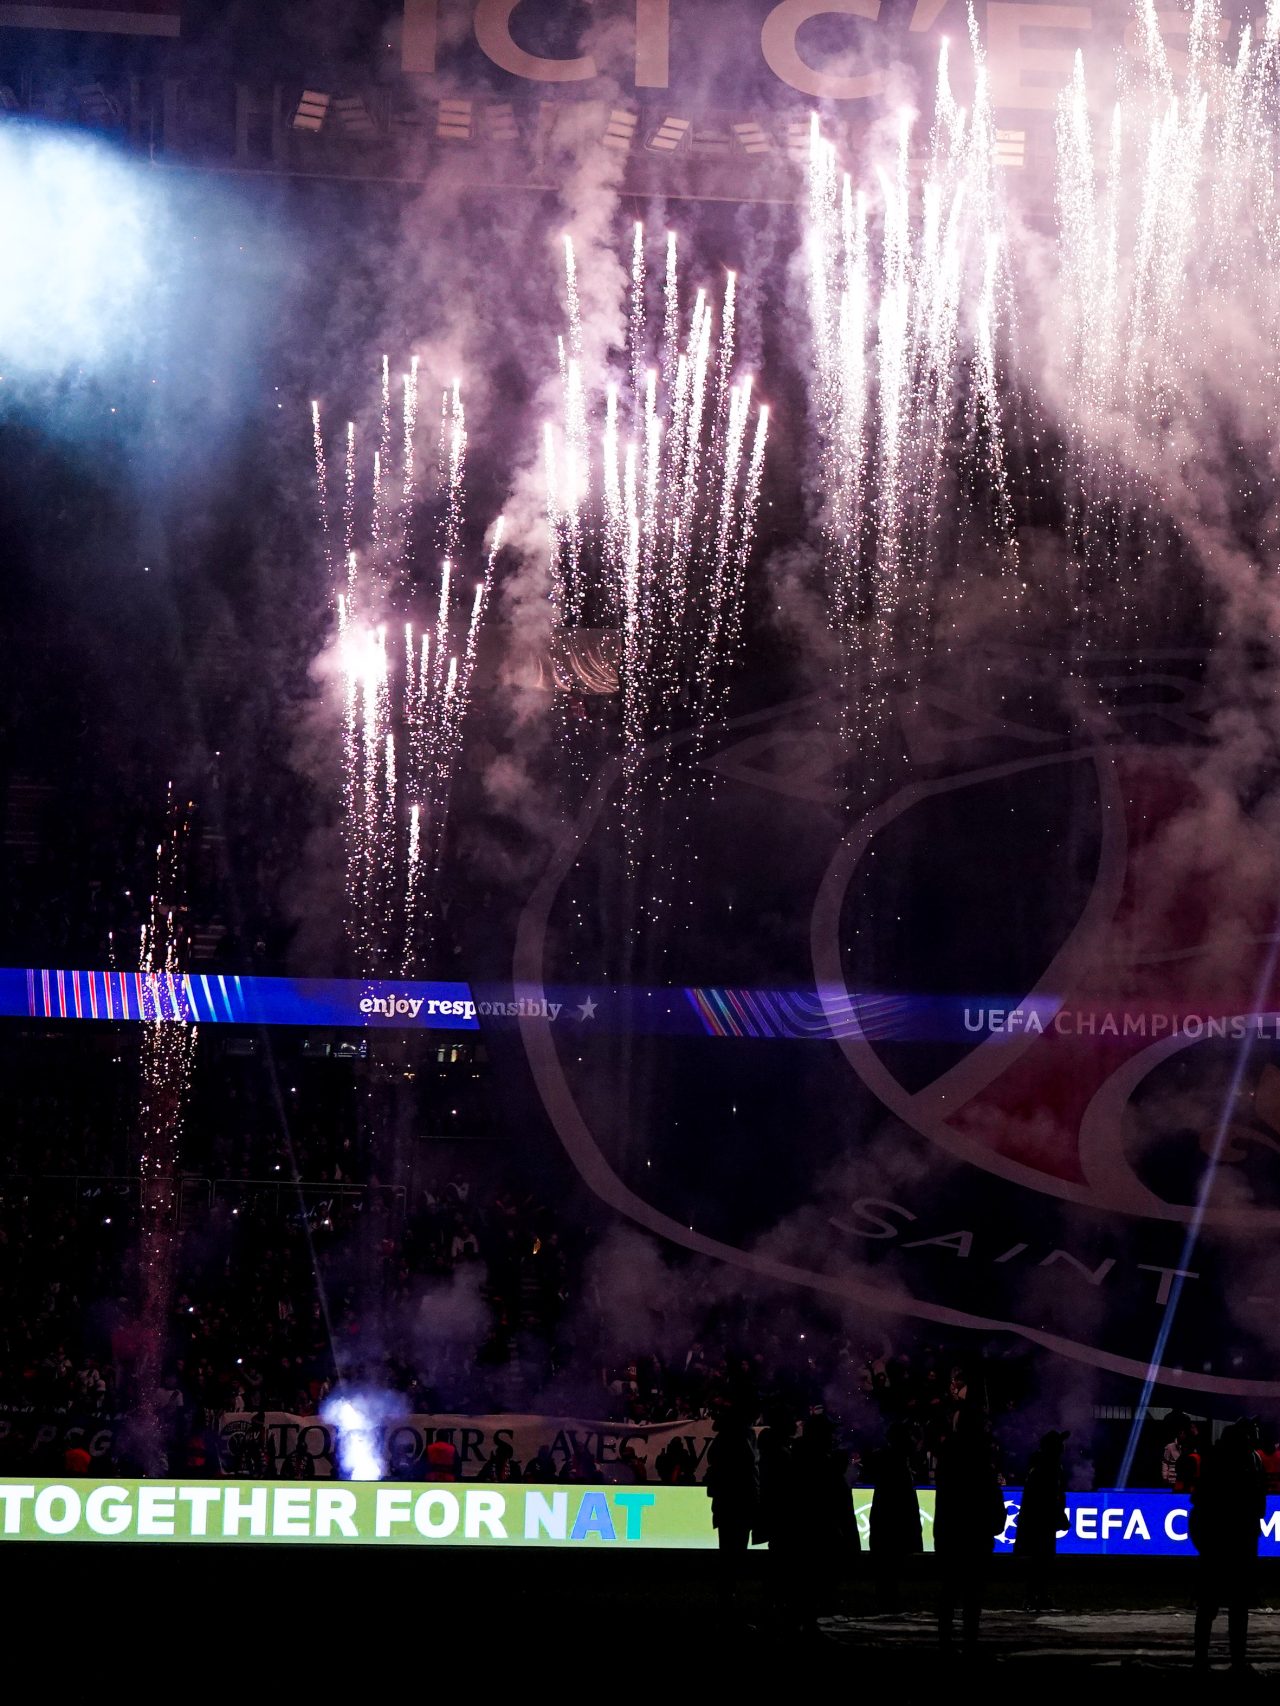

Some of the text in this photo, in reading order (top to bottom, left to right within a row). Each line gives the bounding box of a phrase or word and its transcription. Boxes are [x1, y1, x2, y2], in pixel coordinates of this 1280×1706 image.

[359, 994, 562, 1021] enjoy responsibly
[964, 1008, 1044, 1034] UEFA
[1054, 1010, 1246, 1039] CHAMPIONS
[0, 1484, 654, 1540] TOGETHER FOR NAT
